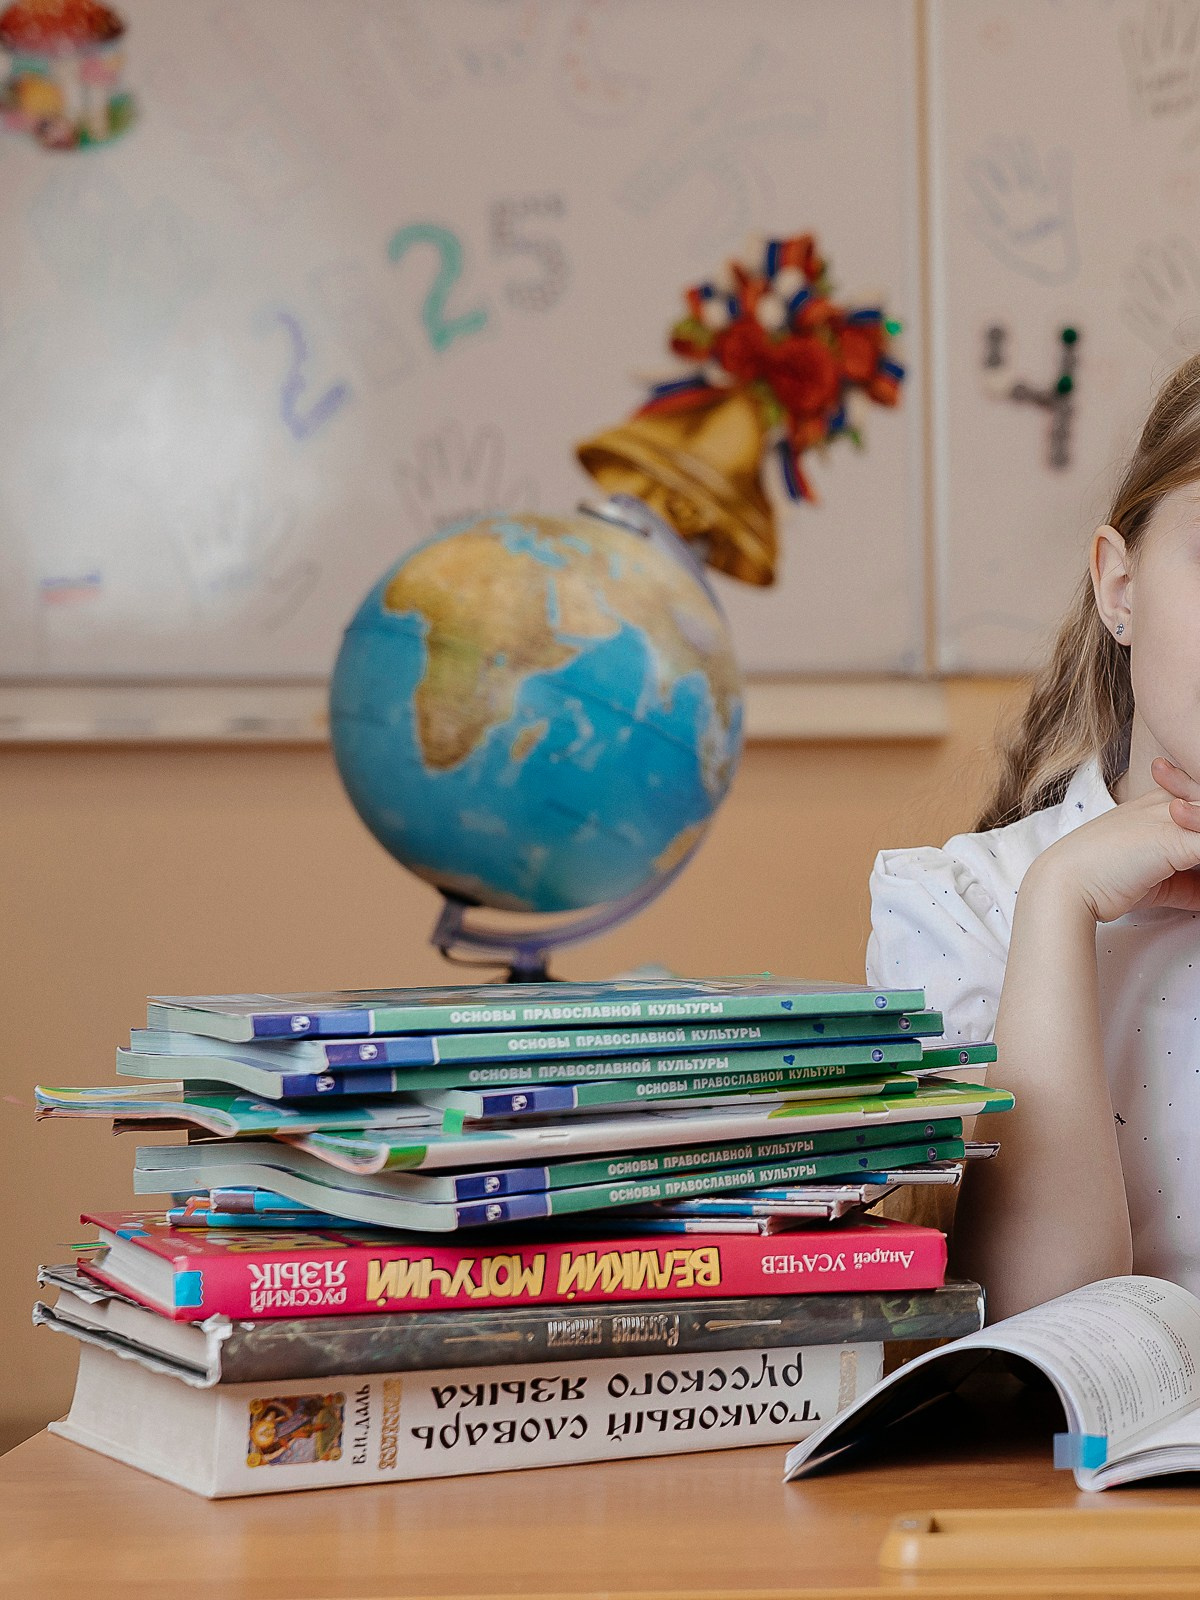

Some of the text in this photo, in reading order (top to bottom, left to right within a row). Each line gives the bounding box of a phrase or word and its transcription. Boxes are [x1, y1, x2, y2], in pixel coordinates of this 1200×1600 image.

[981, 322, 1082, 471] 4
[450, 1002, 724, 1024] ОСНОВЫ ПРАВОСЛАВНОЙ КУЛЬТУРЫ
[508, 1027, 761, 1051] ОСНОВЫ ПРАВОСЛАВНОЙ КУЛЬТУРЫ
[469, 1057, 729, 1082] ОСНОВЫ ПРАВОСЛАВНОЙ КУЛЬТУРЫ
[636, 1064, 846, 1096] ОСНОВЫ ПРАВОСЛАВНОЙ КУЛЬТУРЫ
[608, 1140, 814, 1176] ОСНОВЫ ПРАВОСЛАВНОЙ КУЛЬТУРЫ
[610, 1164, 817, 1202] ОСНОВЫ ПРАВОСЛАВНОЙ КУЛЬТУРЫ
[247, 1260, 347, 1290] ЯЗЫК
[366, 1247, 721, 1307] ВЕЛИКИЙ МОГУЧИЙ
[762, 1250, 915, 1274] Андрей УСАЧЕВ
